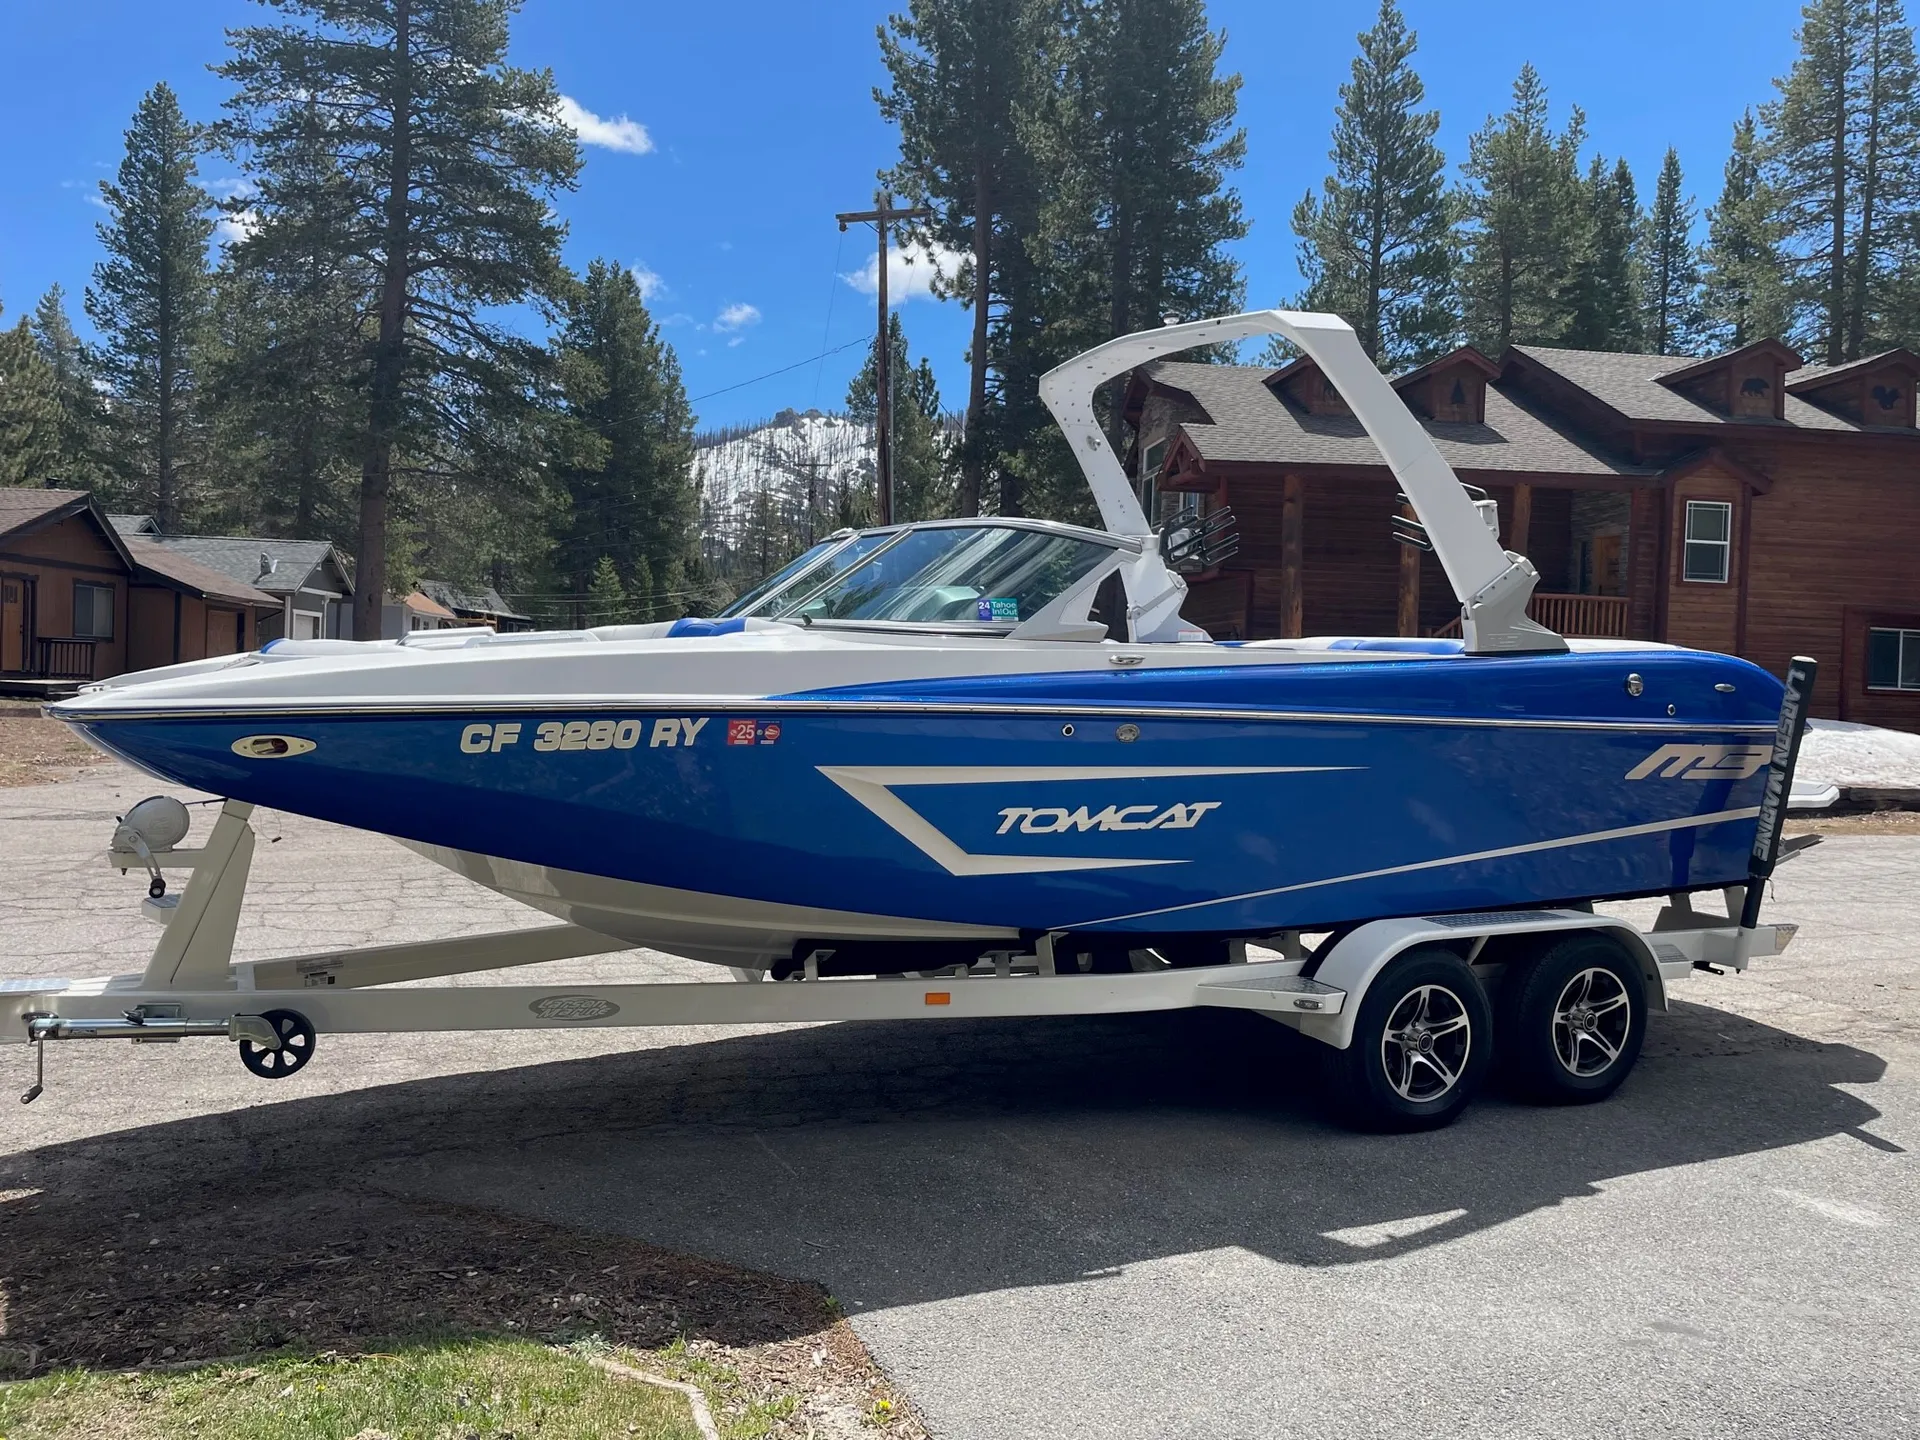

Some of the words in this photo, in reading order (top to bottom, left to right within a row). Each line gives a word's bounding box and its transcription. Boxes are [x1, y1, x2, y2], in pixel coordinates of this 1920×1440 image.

[978, 601, 990, 610] 24
[991, 601, 1017, 609] Tahoe
[1770, 668, 1806, 768] LARSON
[460, 723, 522, 753] CF
[533, 719, 642, 751] 3280
[650, 717, 710, 748] RY
[736, 724, 755, 739] 25
[995, 801, 1222, 835] TOMCAT
[1752, 766, 1785, 862] MARINE
[536, 1007, 612, 1019] Marine
